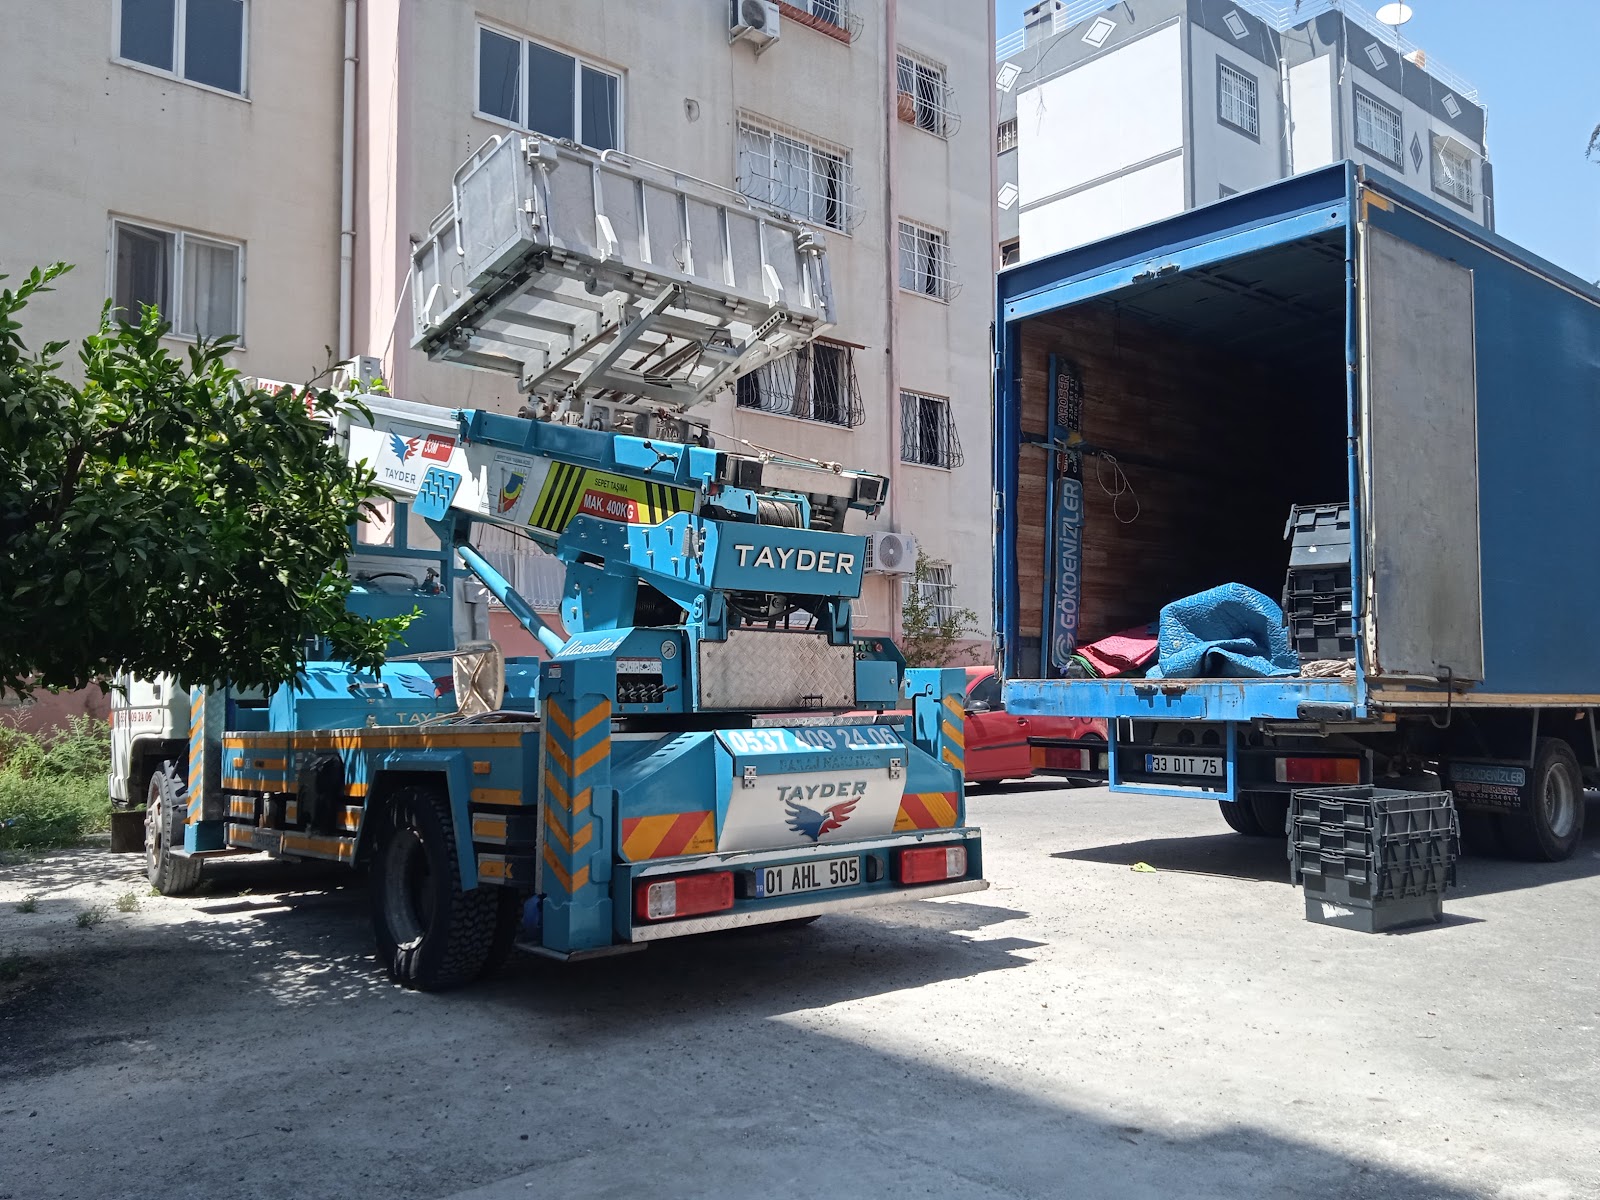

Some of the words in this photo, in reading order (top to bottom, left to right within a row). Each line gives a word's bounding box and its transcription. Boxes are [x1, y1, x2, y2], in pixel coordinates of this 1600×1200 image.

[385, 467, 416, 485] TAYDER
[594, 477, 611, 489] SEPET
[610, 481, 628, 493] TAŞIMA
[583, 493, 605, 513] MAK.
[606, 499, 634, 520] 400KG
[734, 543, 856, 576] TAYDER
[1058, 482, 1080, 629] GÖKDENİZLER
[728, 730, 789, 753] 0537
[795, 727, 837, 750] 409
[836, 727, 869, 749] 24
[867, 727, 898, 746] 06
[1153, 757, 1167, 771] 33
[1173, 757, 1195, 773] DIT
[1202, 759, 1217, 774] 75
[777, 781, 867, 802] TAYDER
[756, 884, 764, 893] TR
[765, 868, 782, 894] 01
[791, 864, 821, 891] AHL
[829, 859, 858, 885] 505
